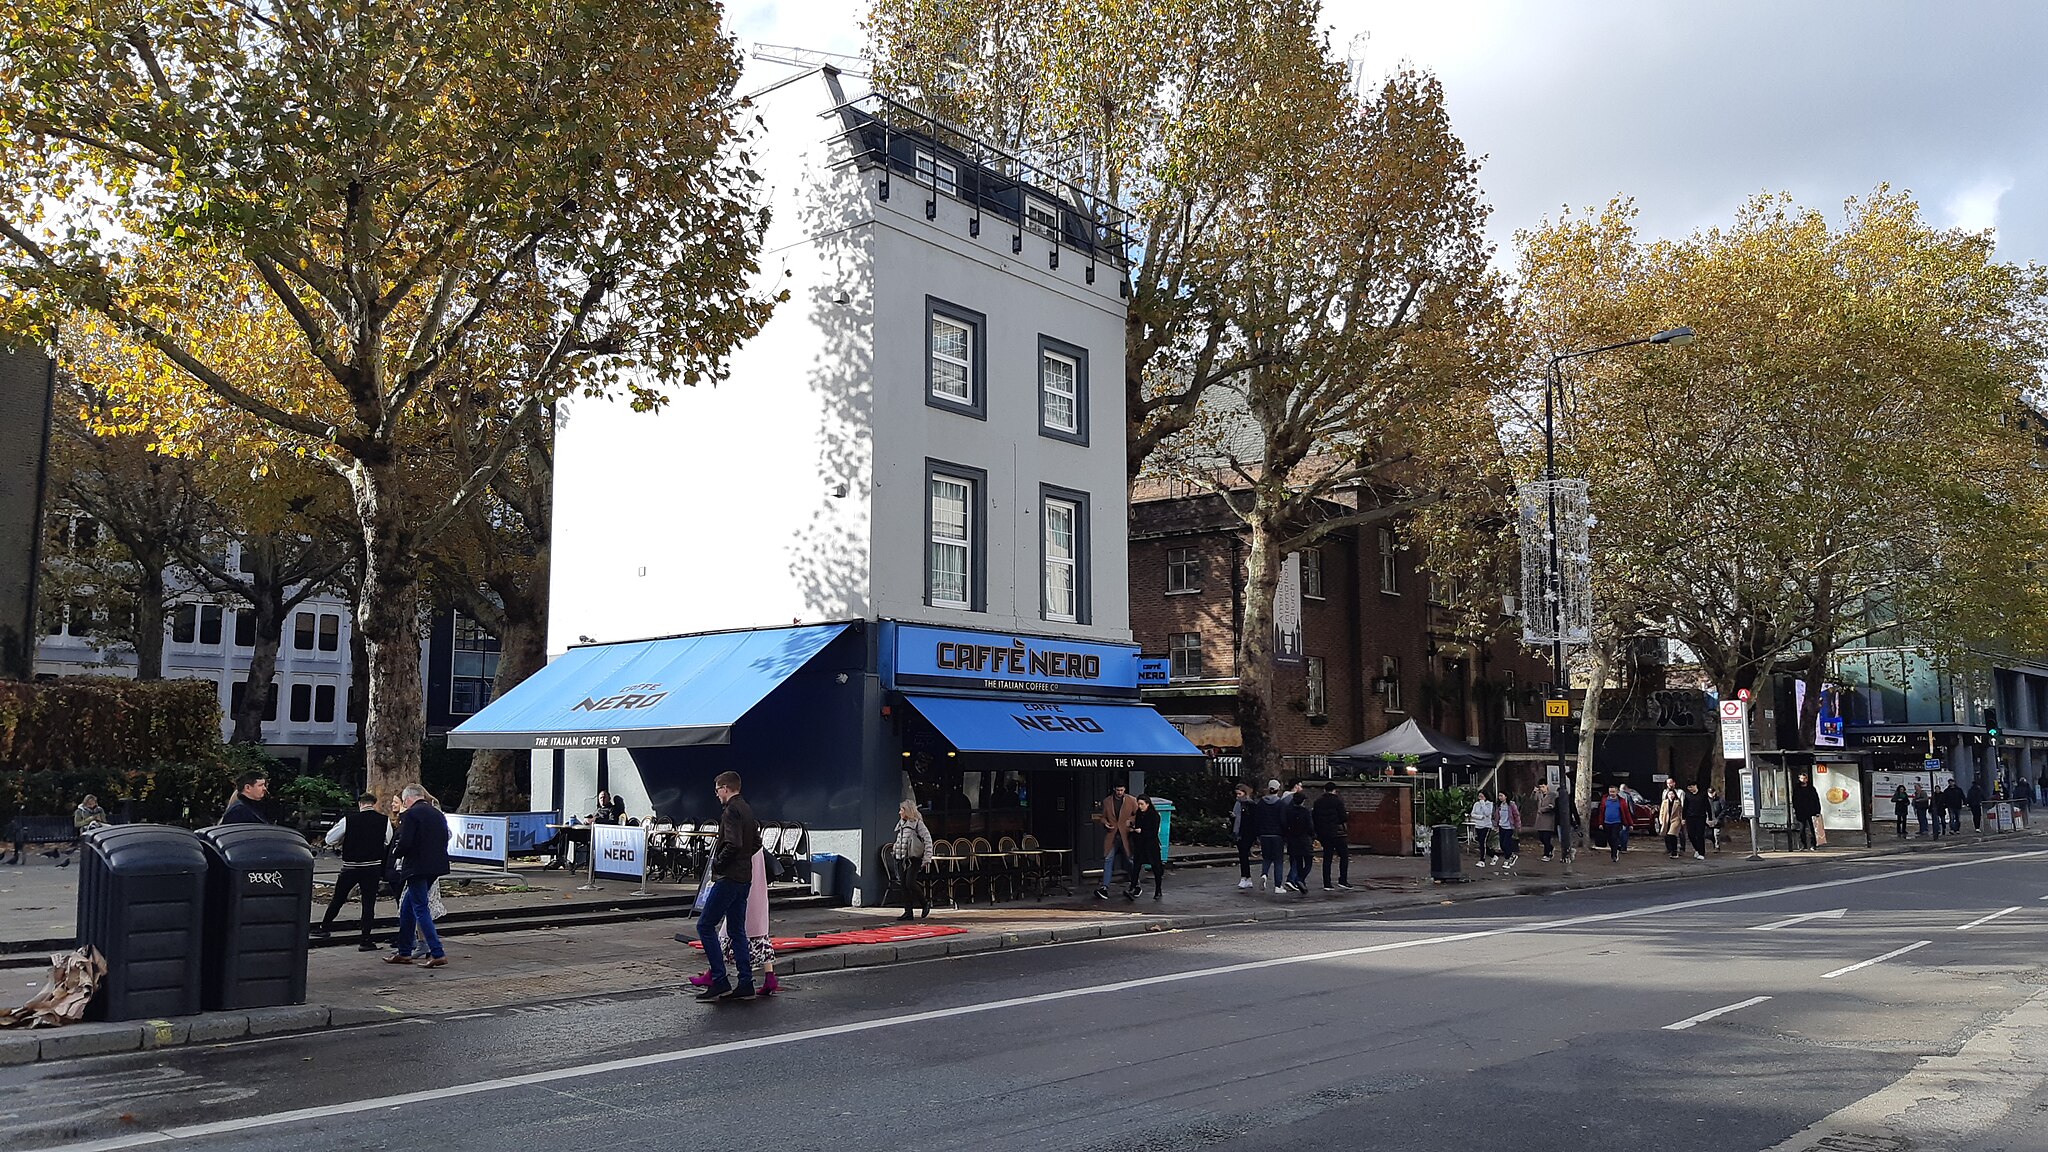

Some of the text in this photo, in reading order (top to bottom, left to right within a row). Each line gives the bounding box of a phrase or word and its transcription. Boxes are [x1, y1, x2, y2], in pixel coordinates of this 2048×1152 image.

[937, 638, 1101, 680] CAFFÈ NERO
[1138, 671, 1166, 679] NERO
[984, 680, 996, 689] THE
[998, 681, 1024, 690] ITALIAN
[1025, 682, 1049, 691] COFFEE
[1739, 689, 1748, 698] A
[570, 691, 669, 712] NERO
[1010, 713, 1104, 733] NERO
[535, 737, 548, 746] THE
[550, 736, 579, 746] ITALIAN
[581, 736, 608, 745] COFFEE
[1862, 735, 1907, 743] NATUZZI
[1974, 735, 1982, 743] N
[1055, 758, 1068, 767] THE
[1070, 758, 1098, 767] ITALIAN
[1100, 759, 1124, 768] COFFEE
[456, 833, 493, 851] NERO
[604, 848, 635, 862] NERO
